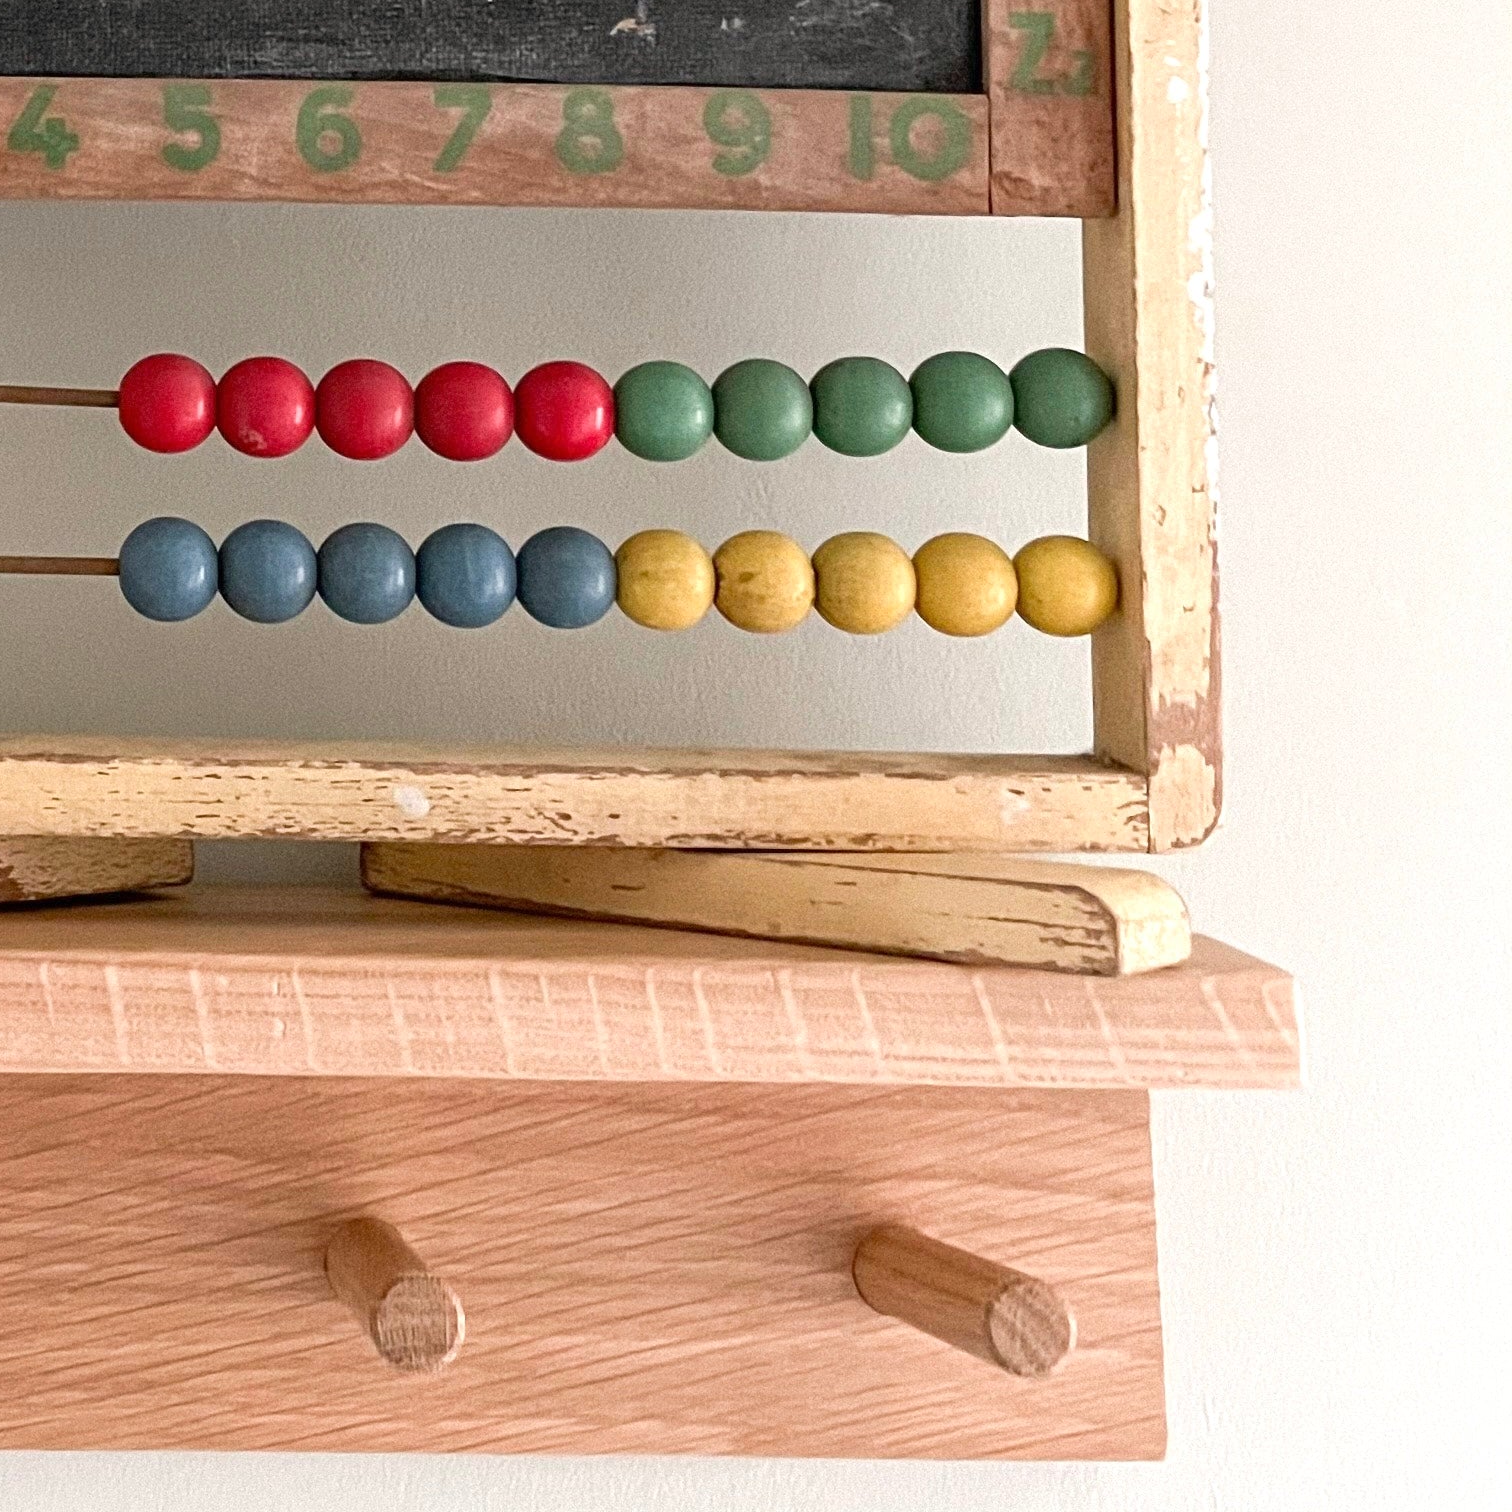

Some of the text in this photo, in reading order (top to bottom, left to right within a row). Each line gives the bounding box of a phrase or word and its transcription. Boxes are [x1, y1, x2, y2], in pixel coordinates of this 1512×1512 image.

[7, 83, 80, 170] 4
[160, 82, 223, 172] 5
[295, 86, 363, 173] 6
[432, 88, 493, 174] 7
[554, 88, 626, 175] 8
[703, 89, 773, 177] 9
[847, 92, 972, 182] 10
